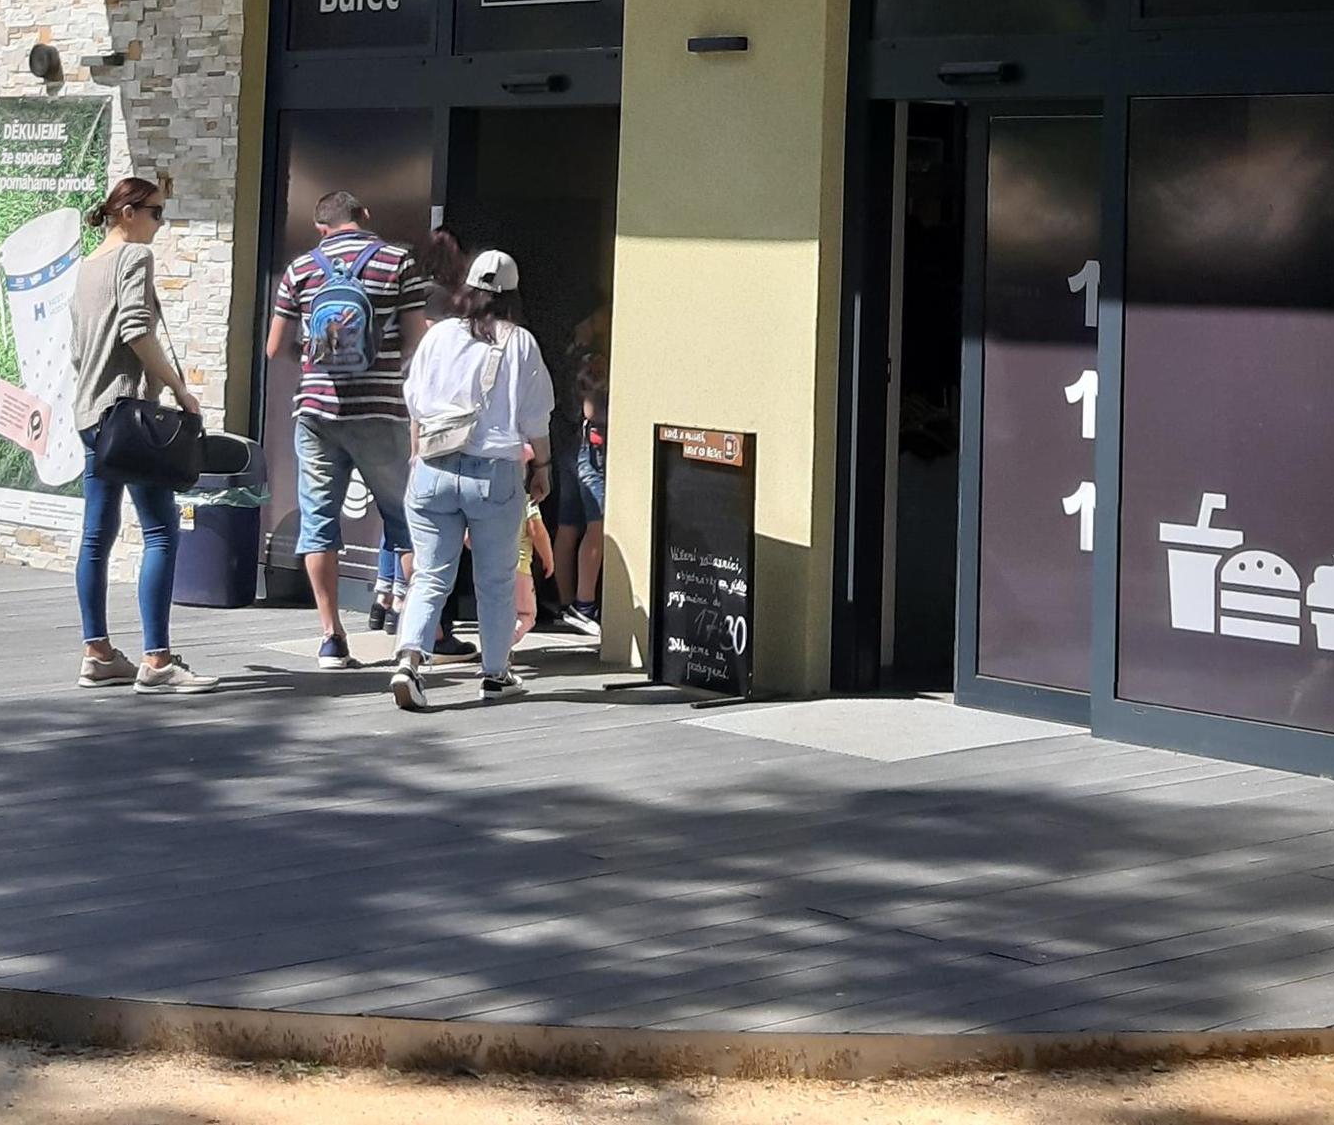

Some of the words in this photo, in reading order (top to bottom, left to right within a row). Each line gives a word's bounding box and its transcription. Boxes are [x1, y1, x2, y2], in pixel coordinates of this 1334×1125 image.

[3, 119, 68, 143] DĚKUJEME,
[1, 148, 13, 165] že
[14, 148, 62, 168] společně
